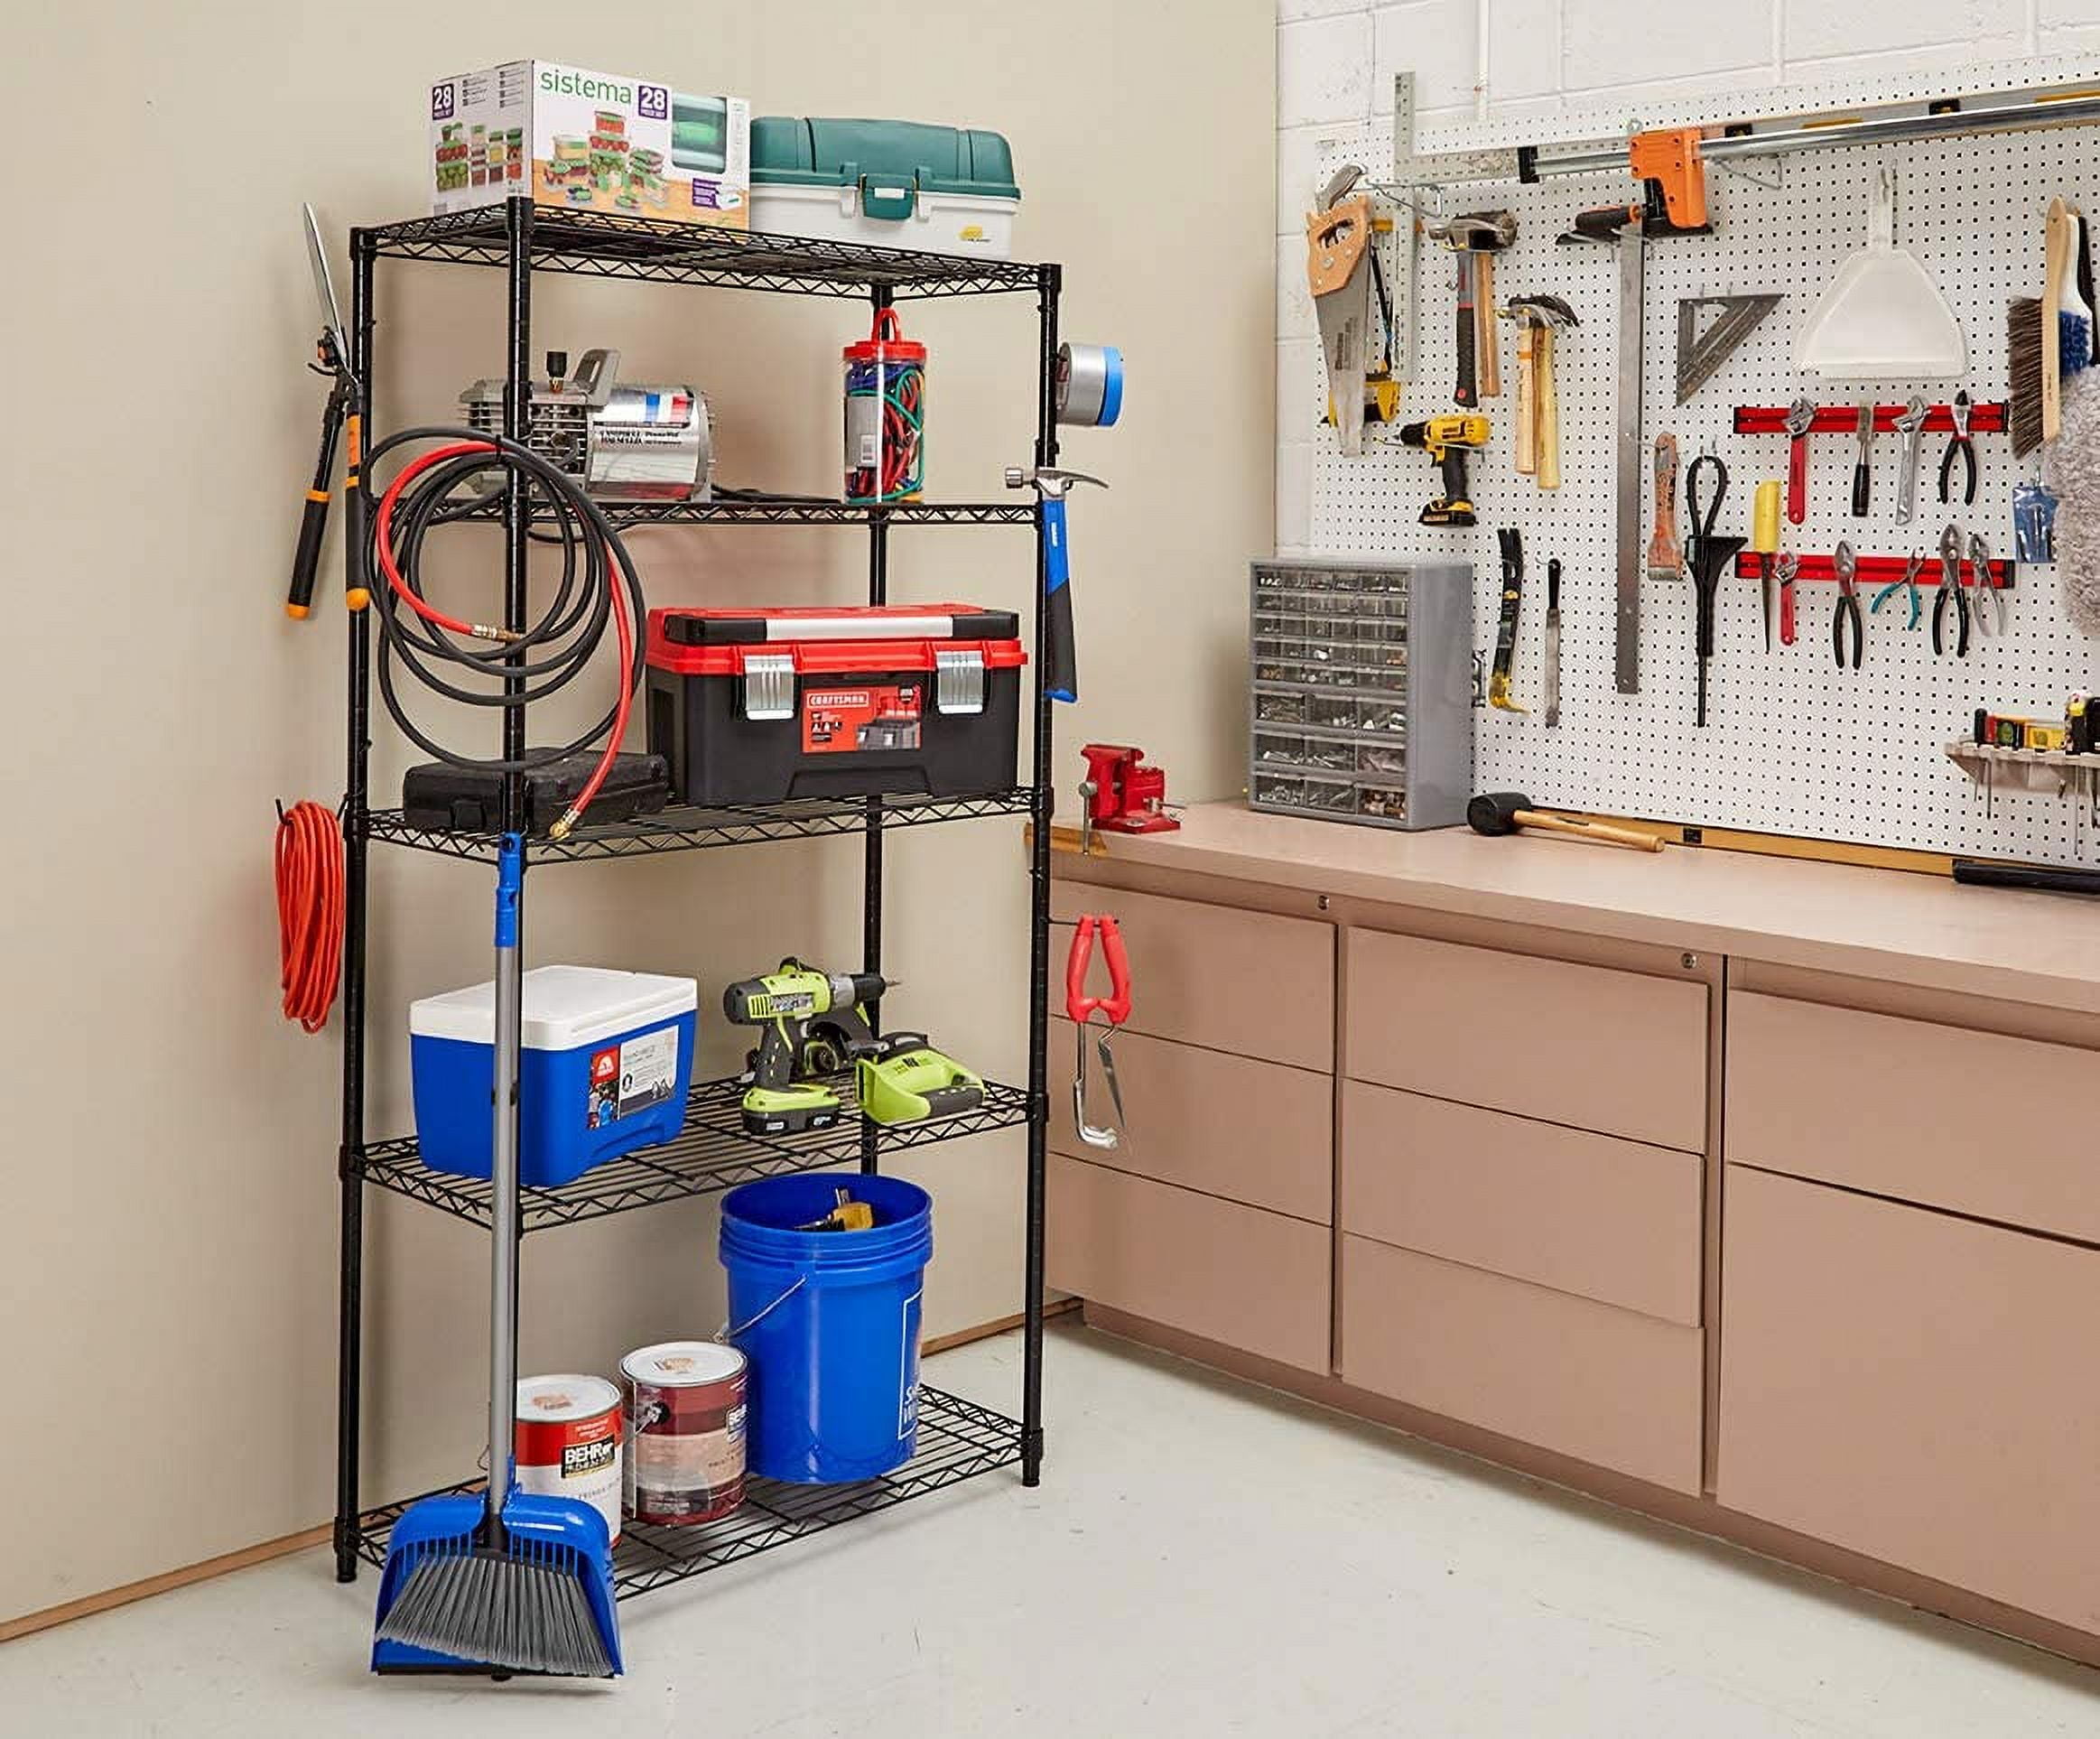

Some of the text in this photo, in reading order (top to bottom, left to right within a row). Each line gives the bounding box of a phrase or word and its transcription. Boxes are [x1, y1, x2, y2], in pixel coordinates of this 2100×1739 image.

[433, 87, 452, 109] 28
[540, 69, 632, 105] sistema
[640, 87, 665, 111] 28
[565, 1443, 603, 1465] BEHR
